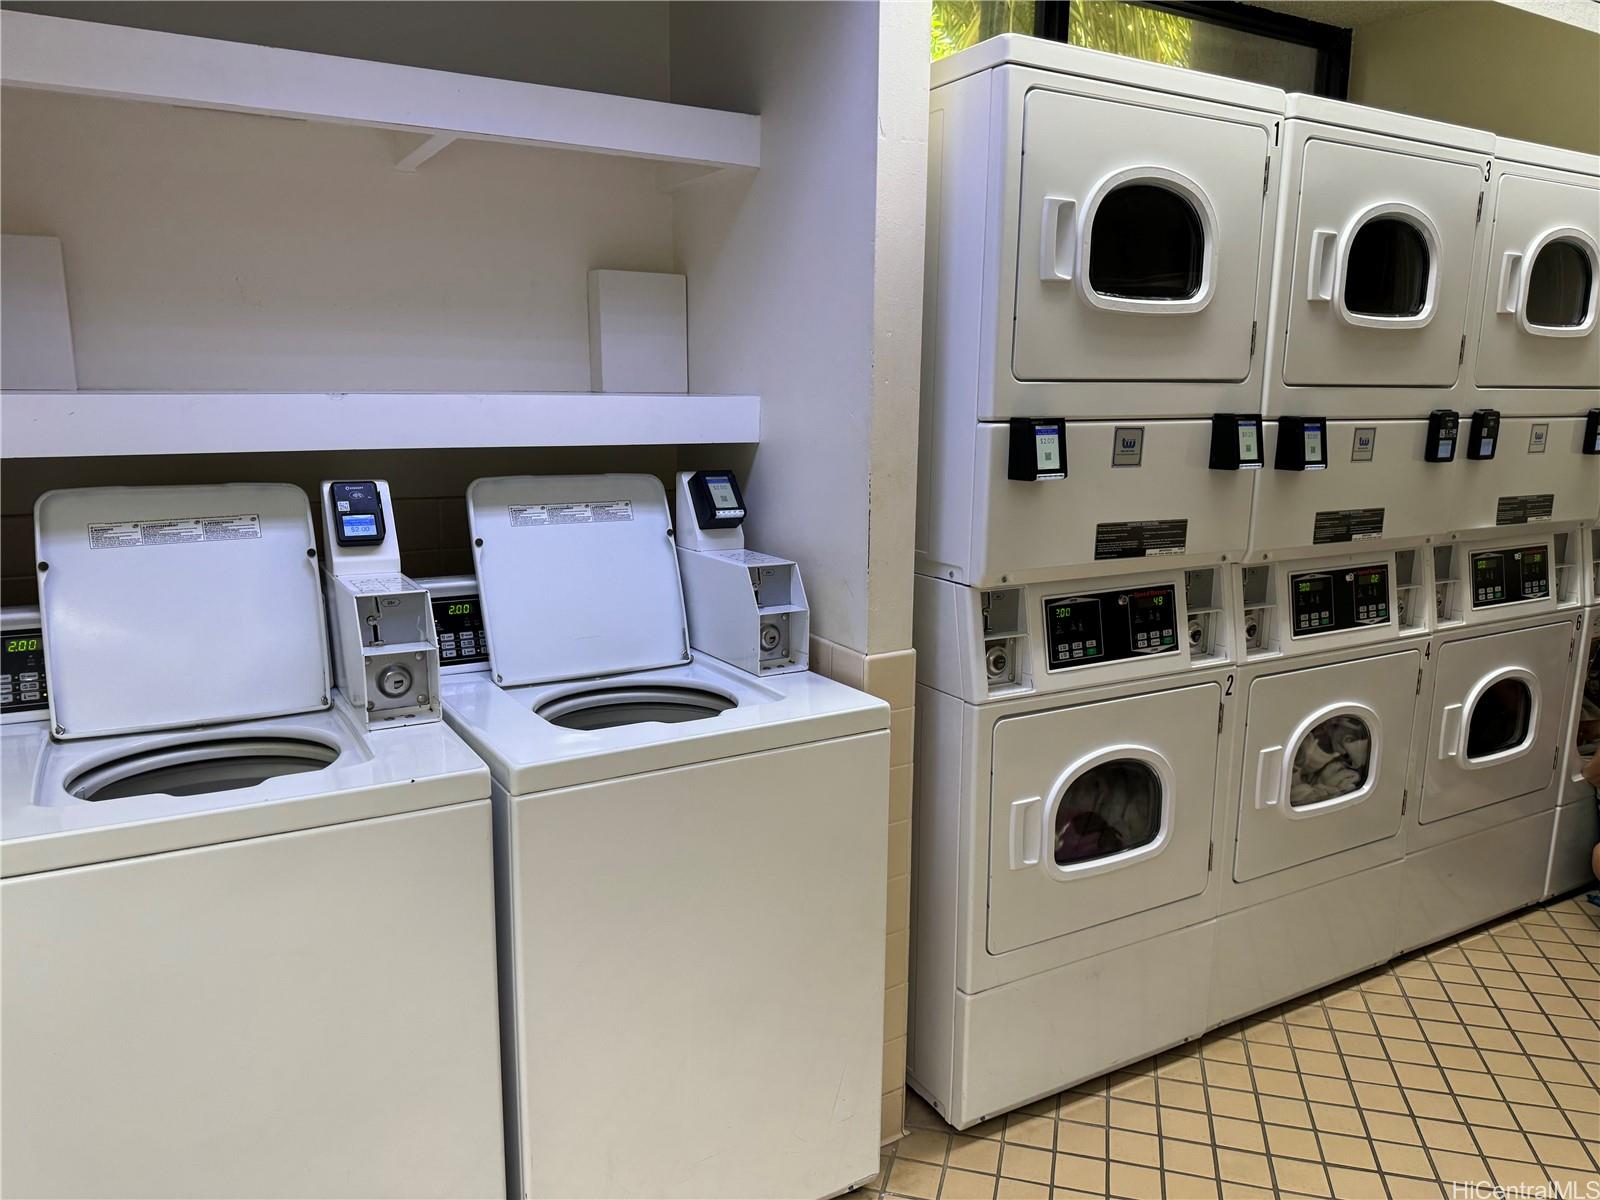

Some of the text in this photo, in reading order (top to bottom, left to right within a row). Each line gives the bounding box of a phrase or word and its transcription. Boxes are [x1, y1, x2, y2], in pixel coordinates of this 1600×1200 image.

[1274, 121, 1280, 147] 1
[1484, 160, 1492, 183] 3
[448, 604, 470, 615] 2.00
[1576, 614, 1582, 631] 6
[8, 639, 37, 652] 2.00
[1425, 641, 1431, 660] 4
[1225, 674, 1234, 696] 2
